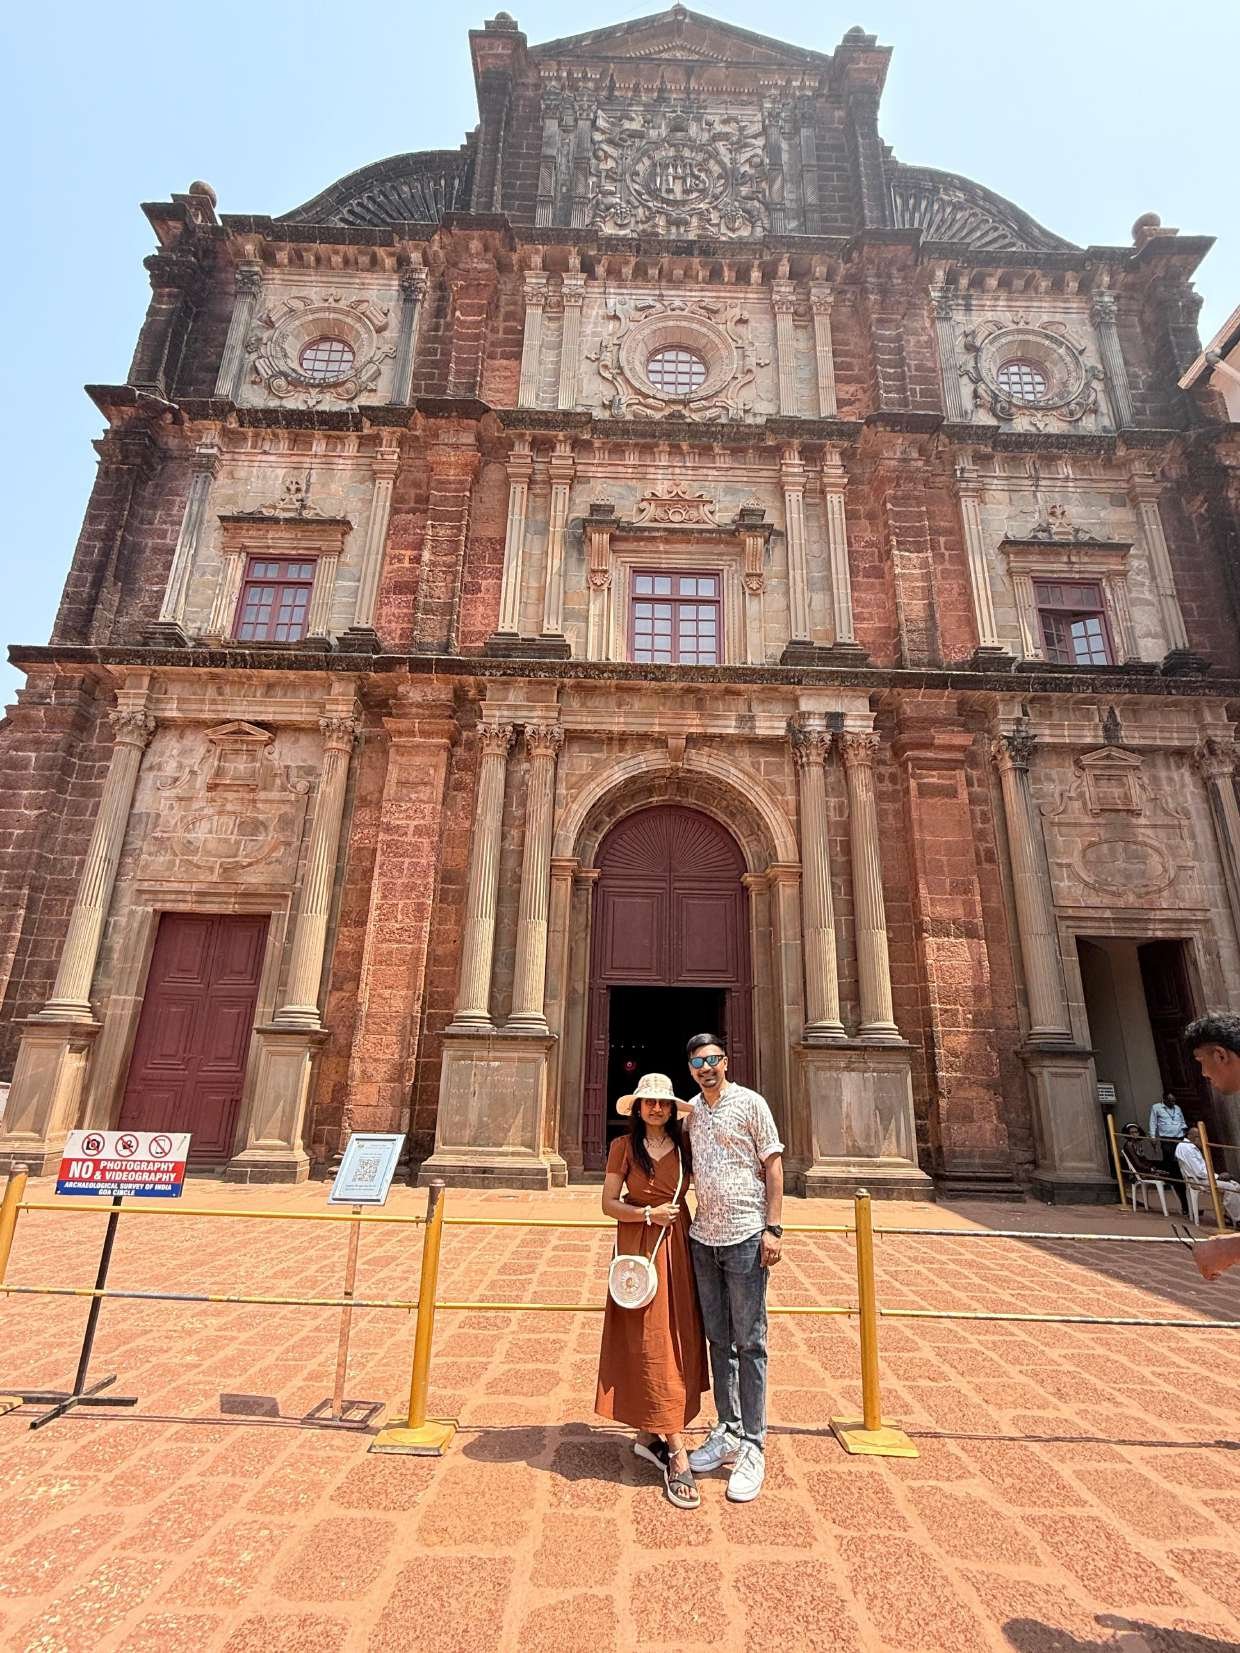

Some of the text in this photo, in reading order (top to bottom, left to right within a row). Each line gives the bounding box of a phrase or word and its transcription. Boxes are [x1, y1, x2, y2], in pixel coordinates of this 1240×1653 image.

[69, 1161, 94, 1178] NO
[100, 1161, 174, 1171] PHOTOGRAPHY
[94, 1172, 176, 1181] & VIDEOGRAPHY
